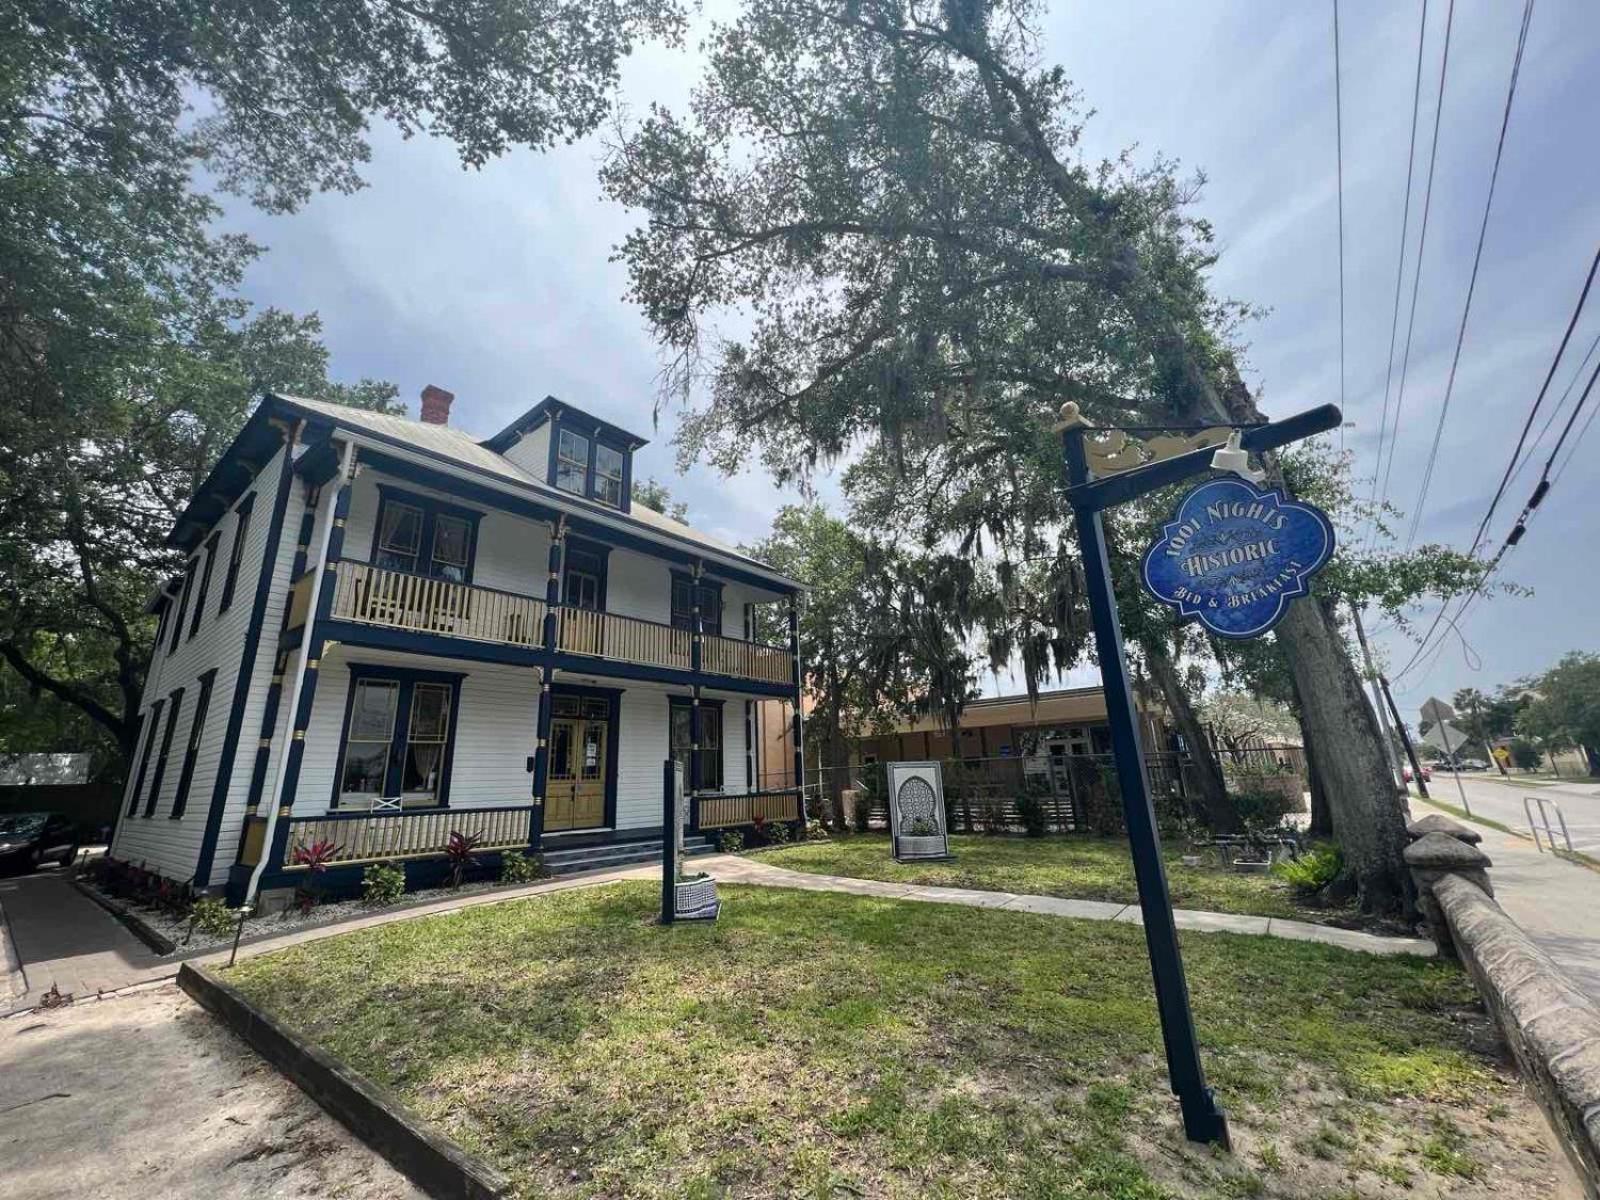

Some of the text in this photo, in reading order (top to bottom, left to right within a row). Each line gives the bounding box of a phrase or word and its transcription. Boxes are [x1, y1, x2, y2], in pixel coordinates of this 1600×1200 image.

[1166, 500, 1289, 557] 1001 NIGHTS
[1182, 539, 1281, 577] HISTORIC
[1174, 560, 1302, 609] BED & BREAKFAST
